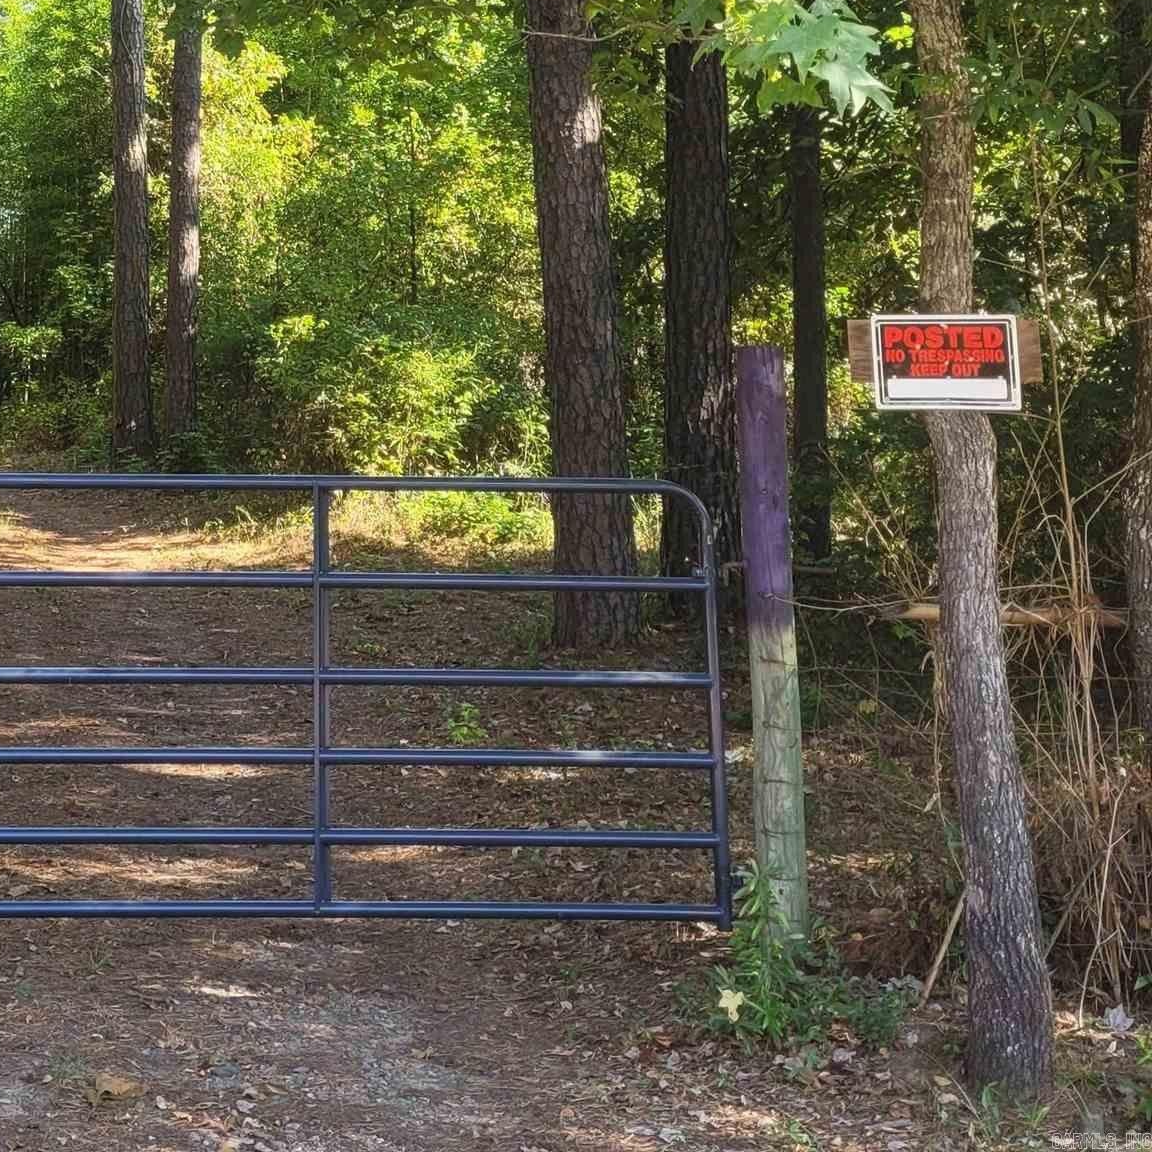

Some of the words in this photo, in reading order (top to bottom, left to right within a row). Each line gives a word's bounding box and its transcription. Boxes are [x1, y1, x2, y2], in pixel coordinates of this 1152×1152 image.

[884, 326, 1003, 348] POSTED
[885, 349, 905, 362] NO
[911, 349, 1004, 362] TRESPASSING
[910, 363, 946, 376] KEEP
[952, 363, 981, 376] OUT
